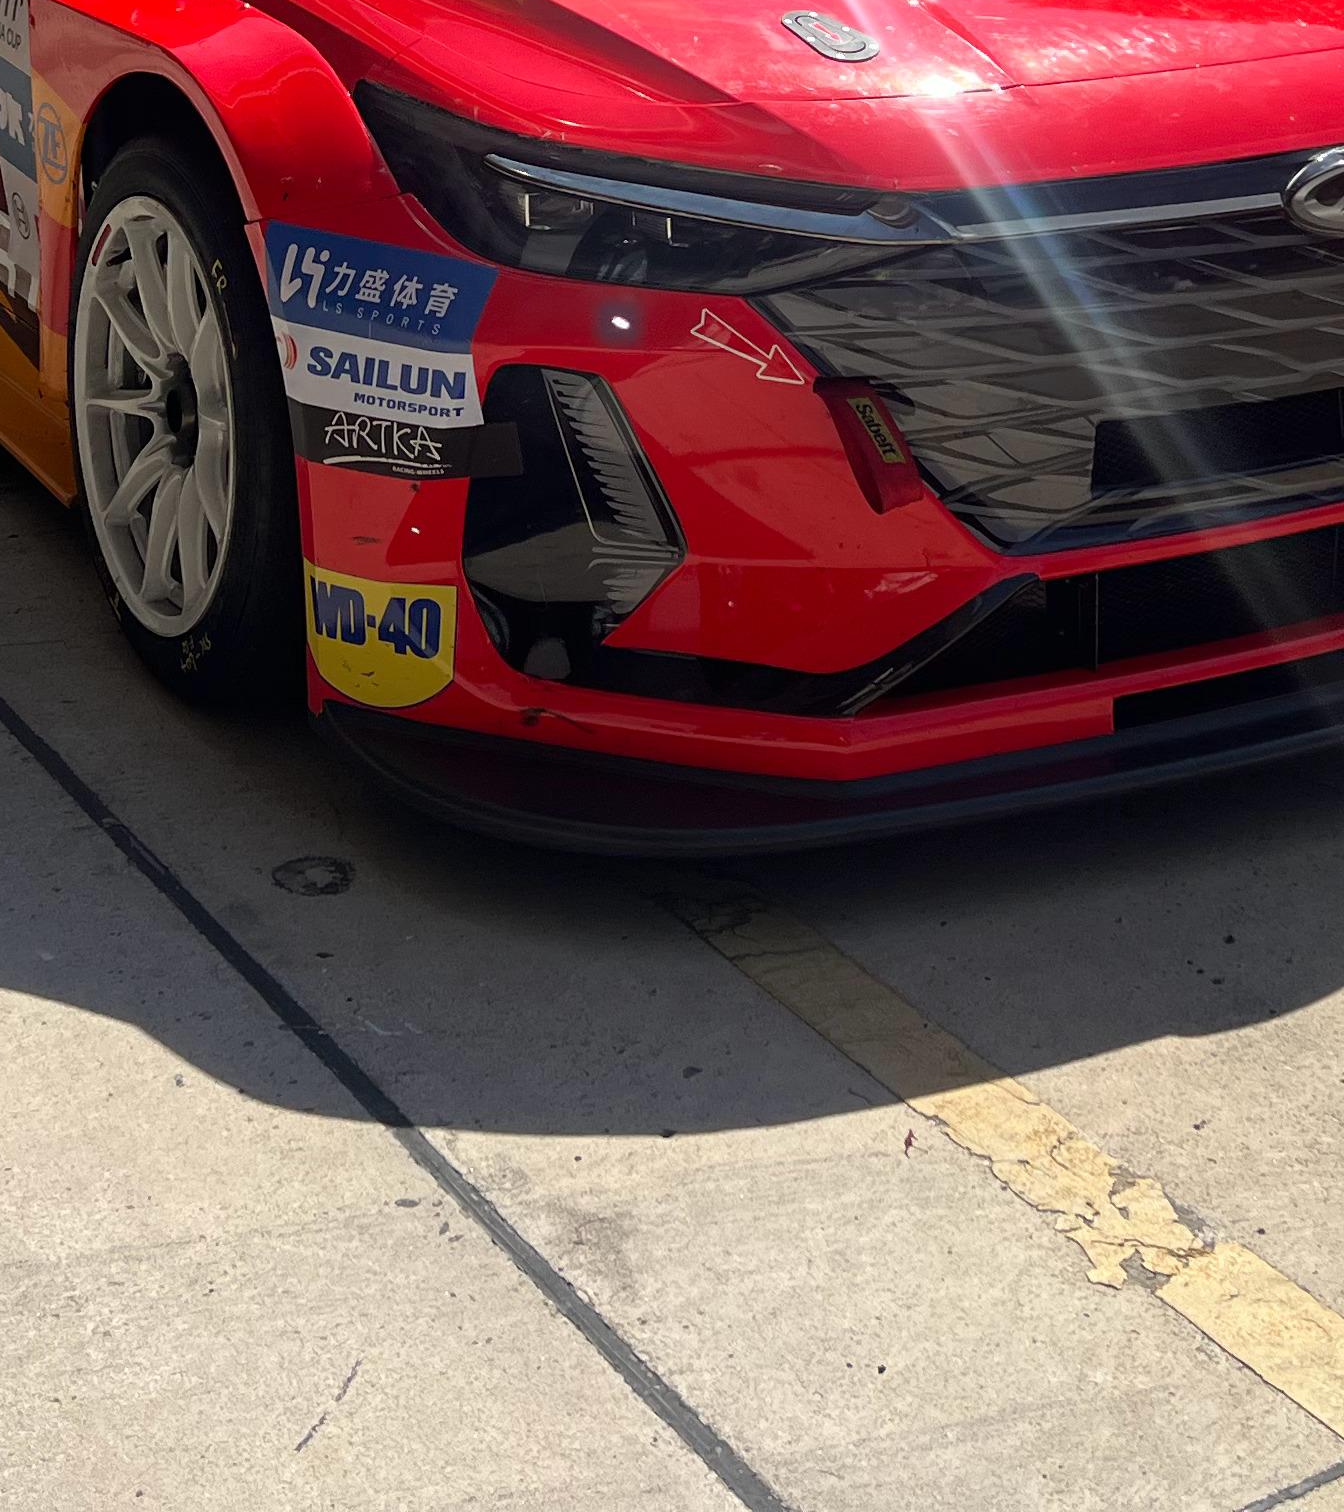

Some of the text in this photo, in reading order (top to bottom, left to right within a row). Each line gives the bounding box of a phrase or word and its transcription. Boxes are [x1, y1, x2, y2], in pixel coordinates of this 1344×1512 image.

[6, 25, 22, 50] CUP
[325, 261, 459, 319] 力盛体育
[322, 299, 441, 335] LS SPORTS
[307, 346, 467, 400] SAILUN
[354, 392, 465, 418] MOTORSPORT
[324, 410, 443, 461] ARTKA
[310, 574, 441, 659] WD-40
